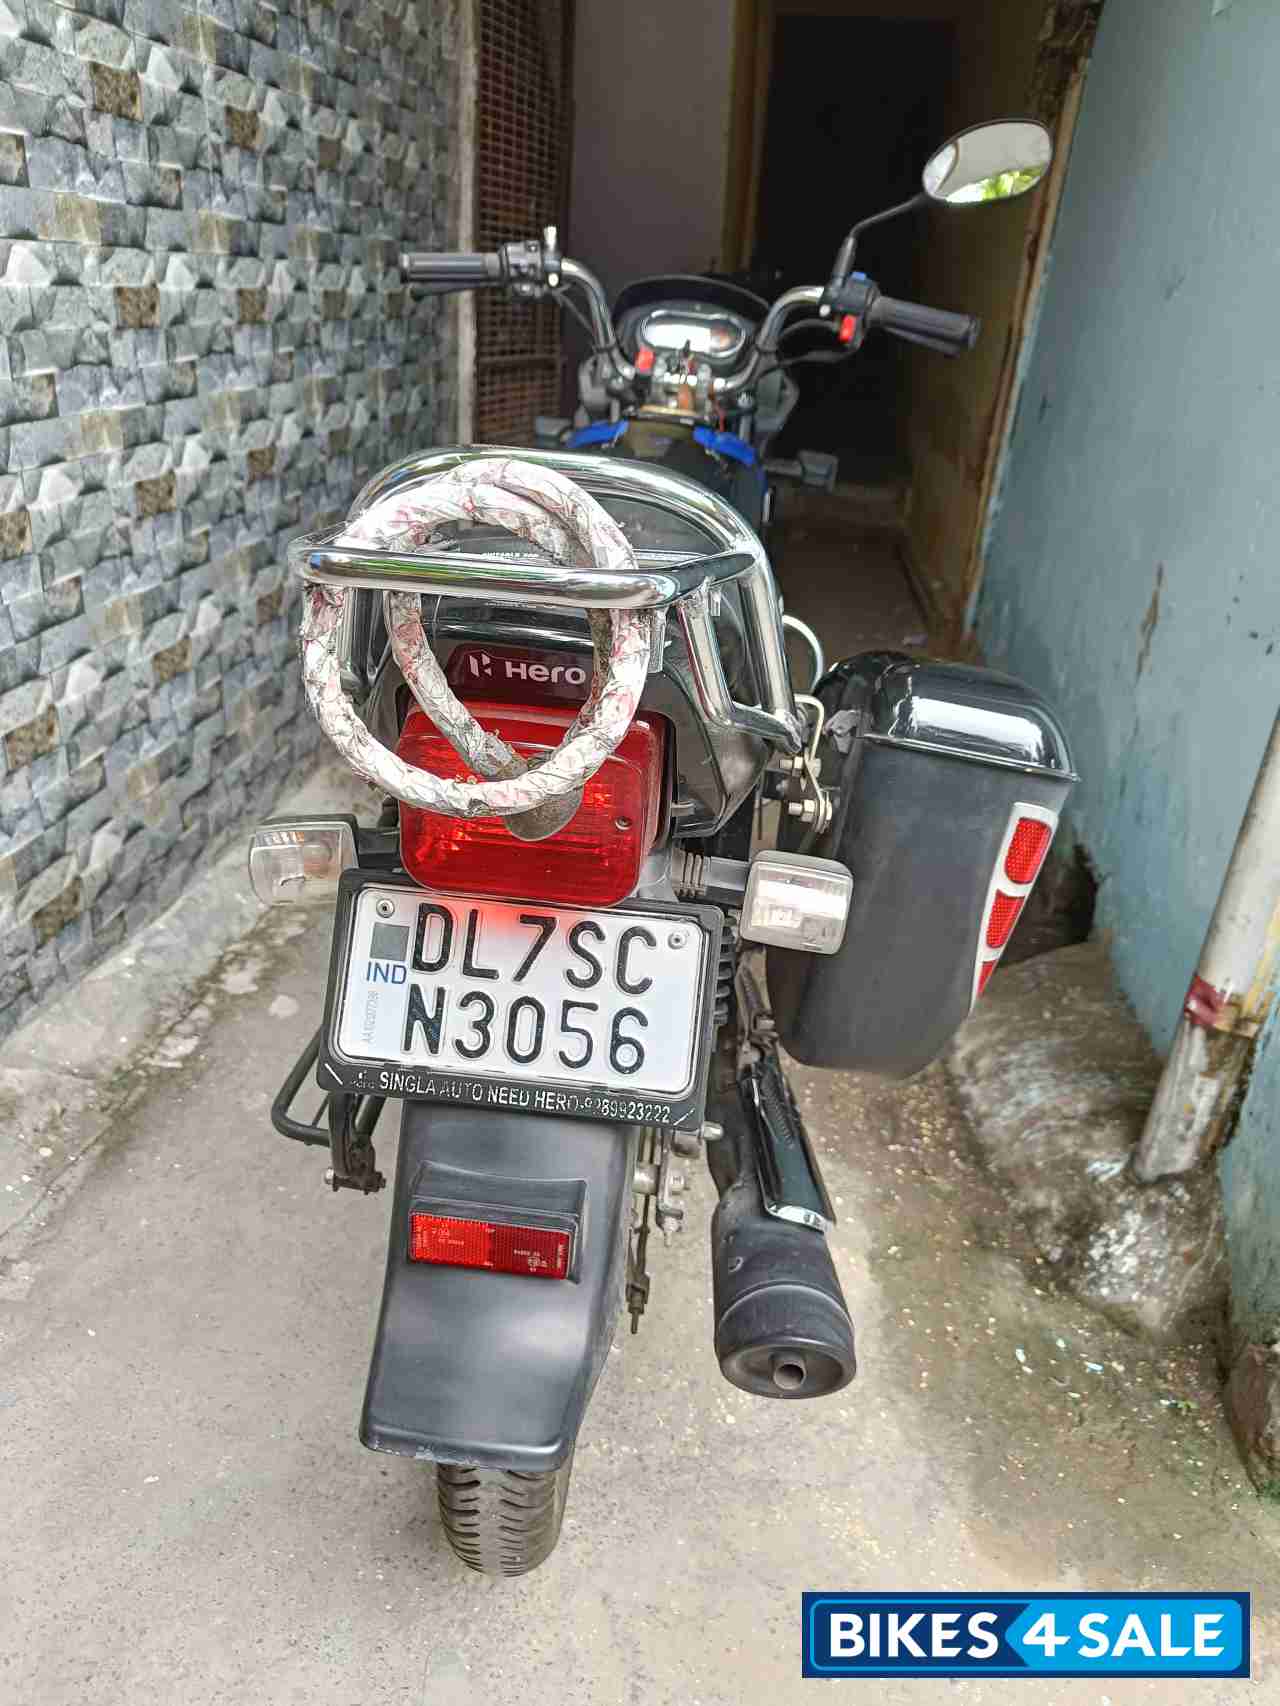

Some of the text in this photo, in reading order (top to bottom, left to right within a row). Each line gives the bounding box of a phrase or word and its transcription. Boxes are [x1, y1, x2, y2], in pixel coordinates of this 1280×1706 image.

[505, 661, 587, 685] Hero
[411, 902, 658, 995] DL7SC
[366, 961, 408, 985] IND
[403, 983, 649, 1075] N3056
[379, 1071, 436, 1095] SINGLA
[487, 1086, 530, 1107] NEED
